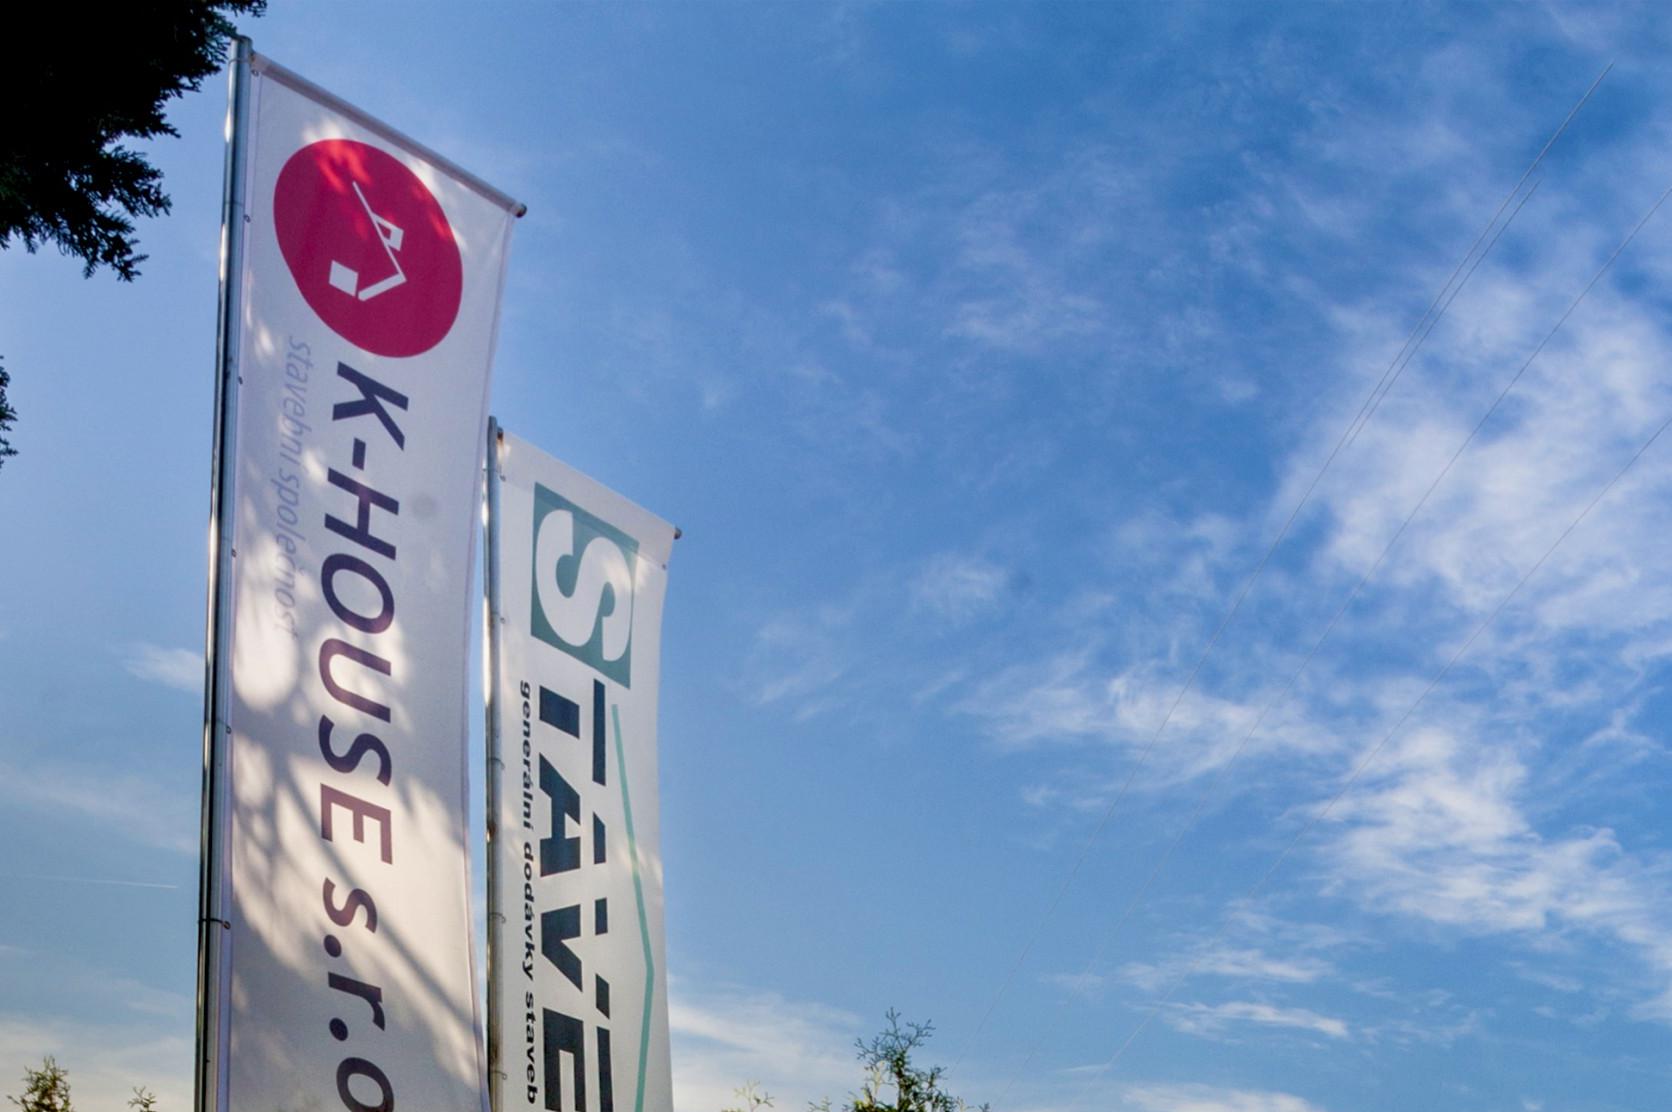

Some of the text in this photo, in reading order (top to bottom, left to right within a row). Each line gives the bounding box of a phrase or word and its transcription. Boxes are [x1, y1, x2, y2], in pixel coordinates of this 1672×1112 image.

[271, 335, 315, 641] stavební společnost
[318, 361, 409, 865] K-HOUSE
[519, 680, 538, 1105] generální dodávky staveb
